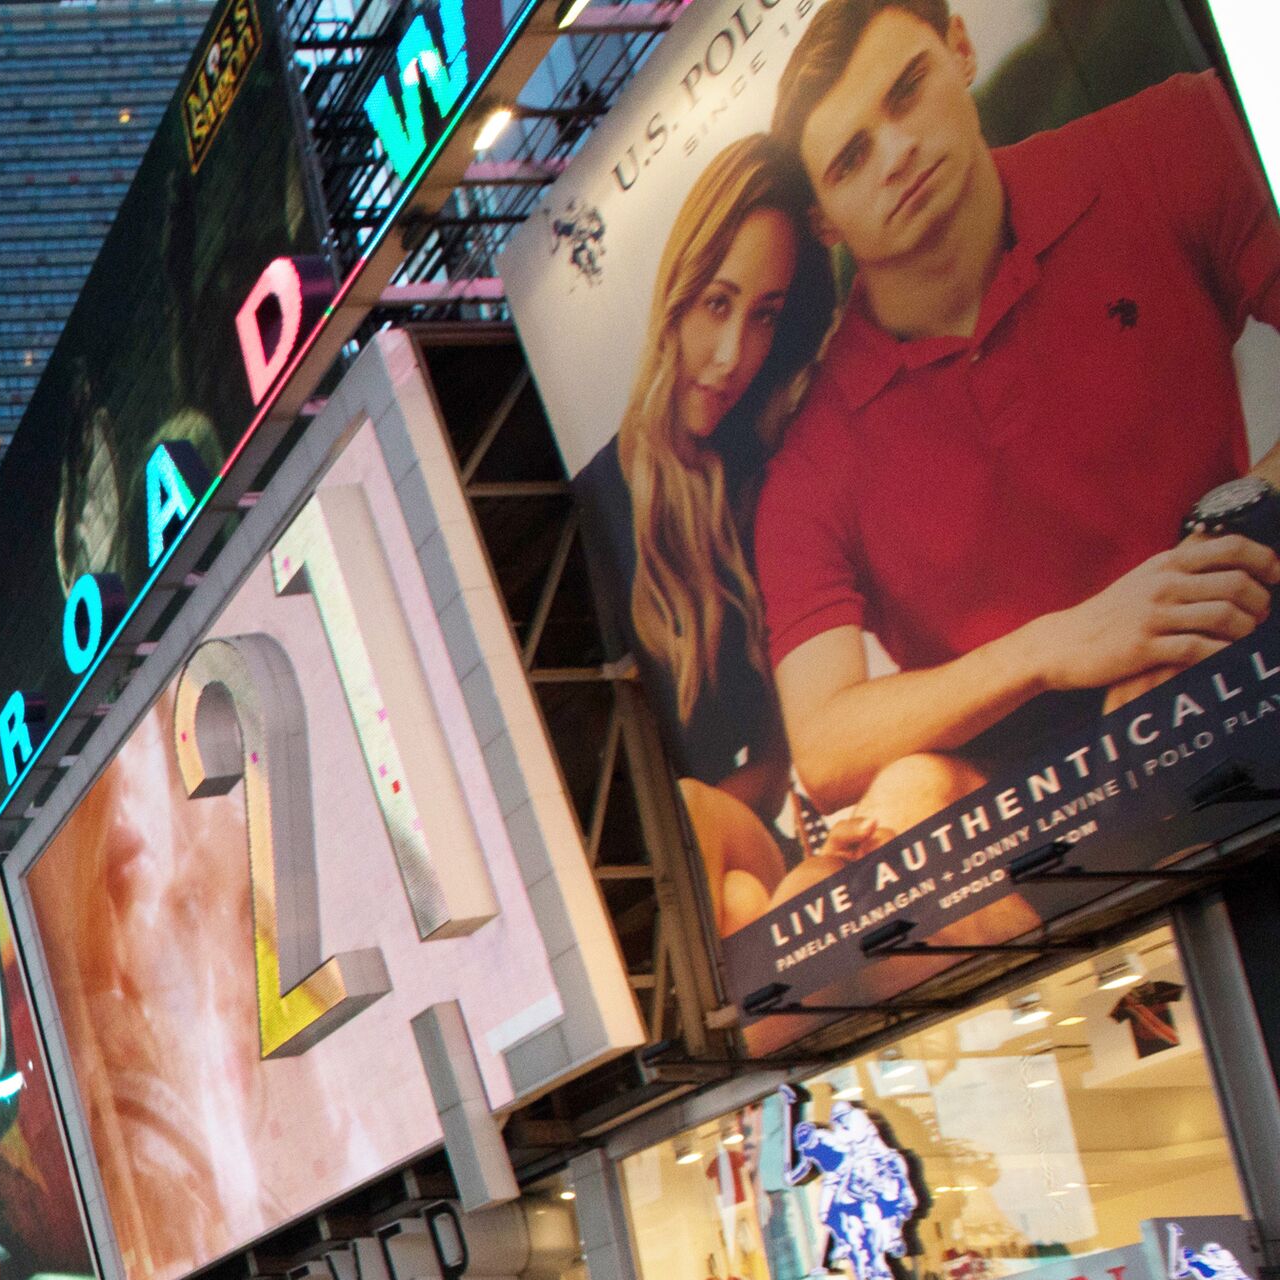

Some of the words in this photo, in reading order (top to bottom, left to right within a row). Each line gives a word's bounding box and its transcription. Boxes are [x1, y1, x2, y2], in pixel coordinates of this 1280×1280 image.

[610, 111, 679, 192] U.S.
[683, 54, 768, 158] SINCE
[775, 931, 842, 973] PAMELA
[839, 877, 937, 941] FLANAGAN
[960, 825, 1031, 876] JONNY
[1037, 779, 1121, 834] LAVINE
[1144, 730, 1215, 777] POLO
[769, 885, 854, 948] LIVE
